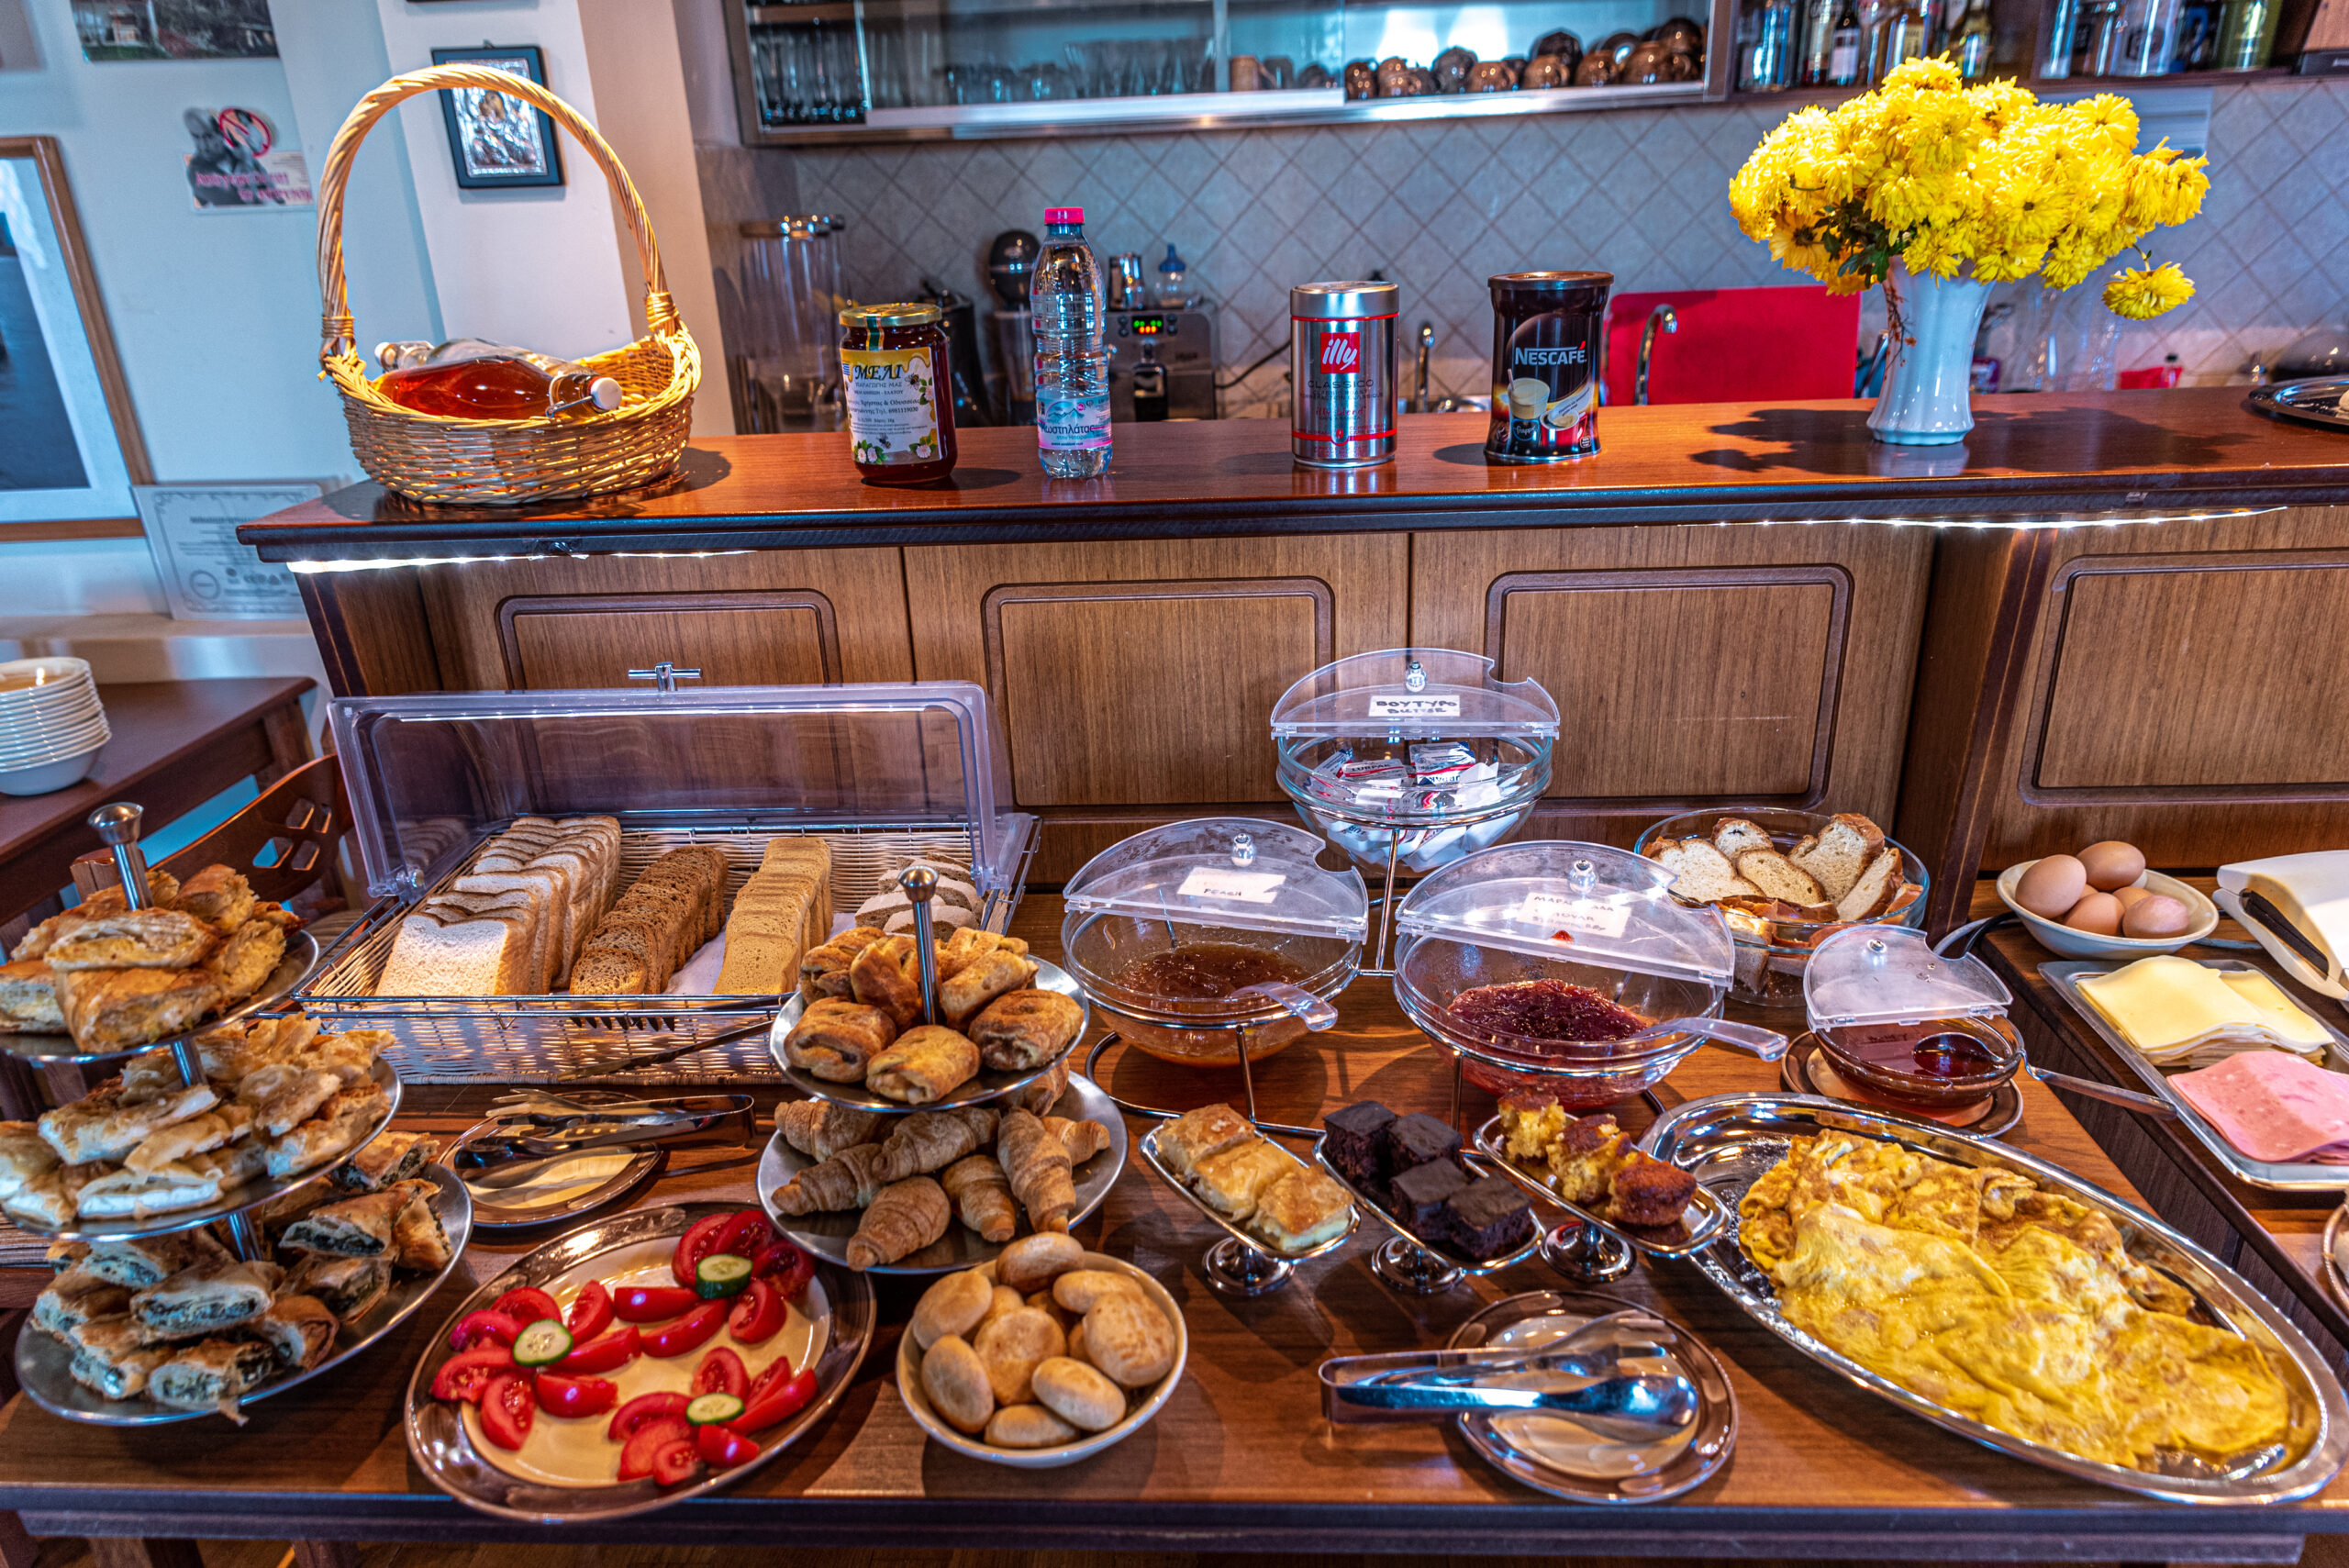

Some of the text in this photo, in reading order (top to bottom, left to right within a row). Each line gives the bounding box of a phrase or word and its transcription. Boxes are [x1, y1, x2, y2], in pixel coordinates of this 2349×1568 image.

[1322, 338, 1358, 371] illy
[1515, 340, 1586, 366] NESCAFÉ
[854, 363, 903, 381] ΜΕΛΙ
[1308, 379, 1375, 389] CLASSICO
[1203, 888, 1241, 896] PEACH
[1533, 895, 1614, 912] ΜΑΡΜΑΔΑ
